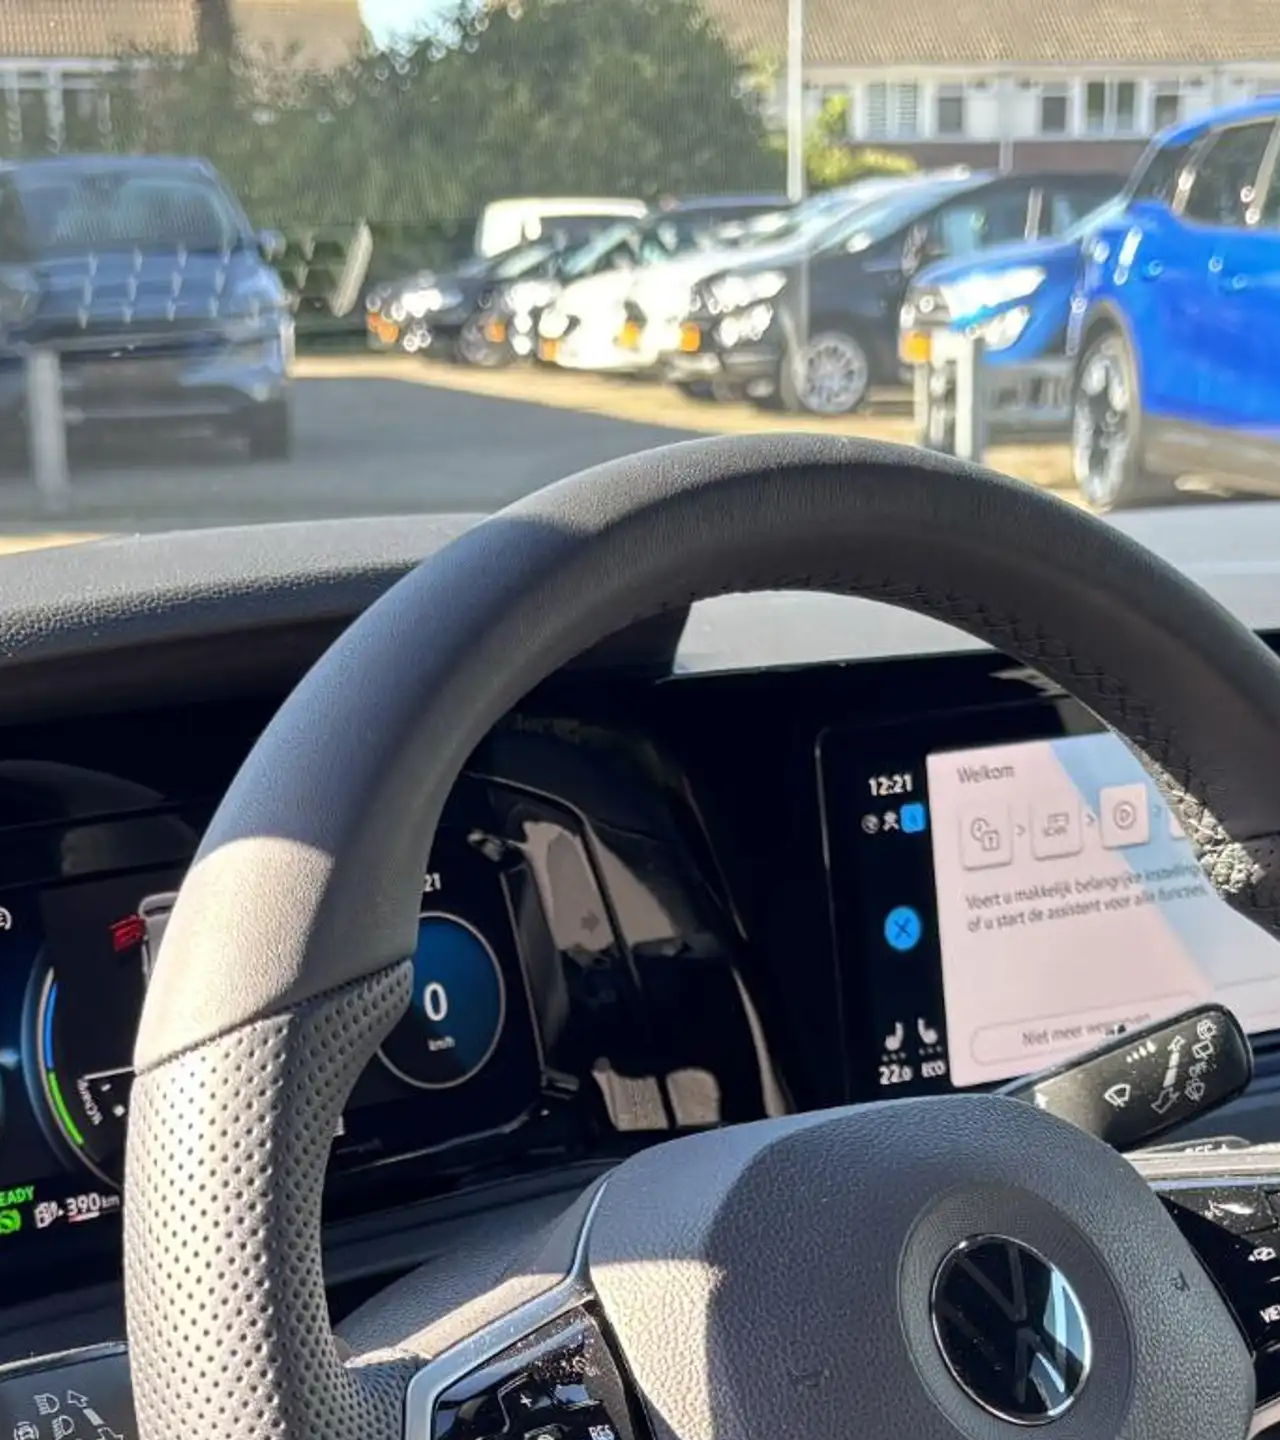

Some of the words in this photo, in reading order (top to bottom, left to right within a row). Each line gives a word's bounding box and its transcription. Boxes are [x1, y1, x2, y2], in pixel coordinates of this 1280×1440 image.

[869, 774, 913, 796] 12:21
[956, 765, 1015, 784] Welkom
[423, 982, 448, 1021] 0
[1022, 1029, 1050, 1046] Niet
[1051, 1026, 1083, 1041] meer
[66, 1193, 101, 1216] 390
